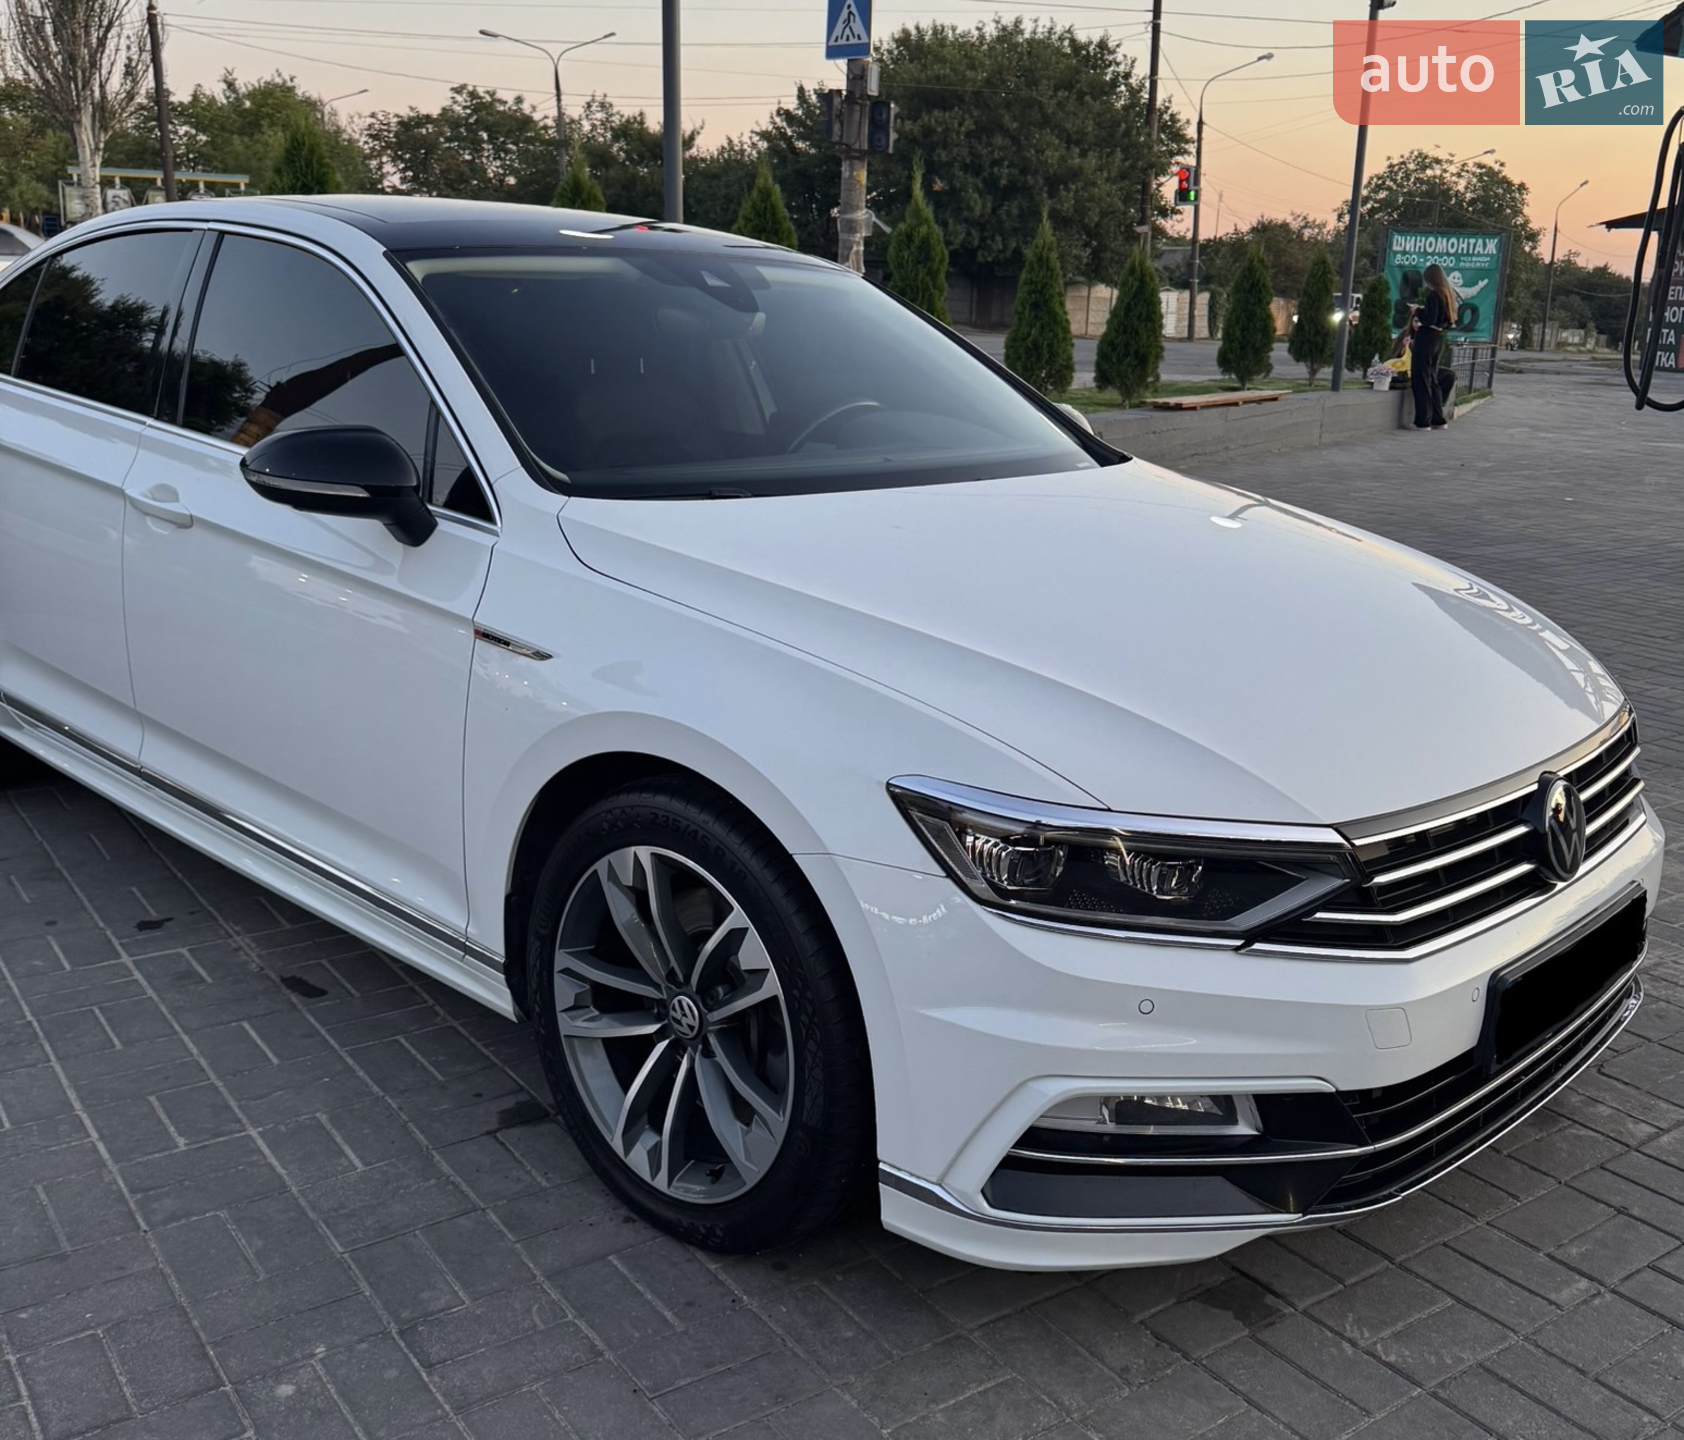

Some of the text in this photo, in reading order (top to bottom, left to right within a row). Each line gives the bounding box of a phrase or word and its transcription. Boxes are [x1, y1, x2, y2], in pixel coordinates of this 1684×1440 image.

[1392, 234, 1498, 255] ШИНОМОНТАЖ
[1394, 254, 1418, 265] 8:00
[1426, 256, 1456, 267] 20:00
